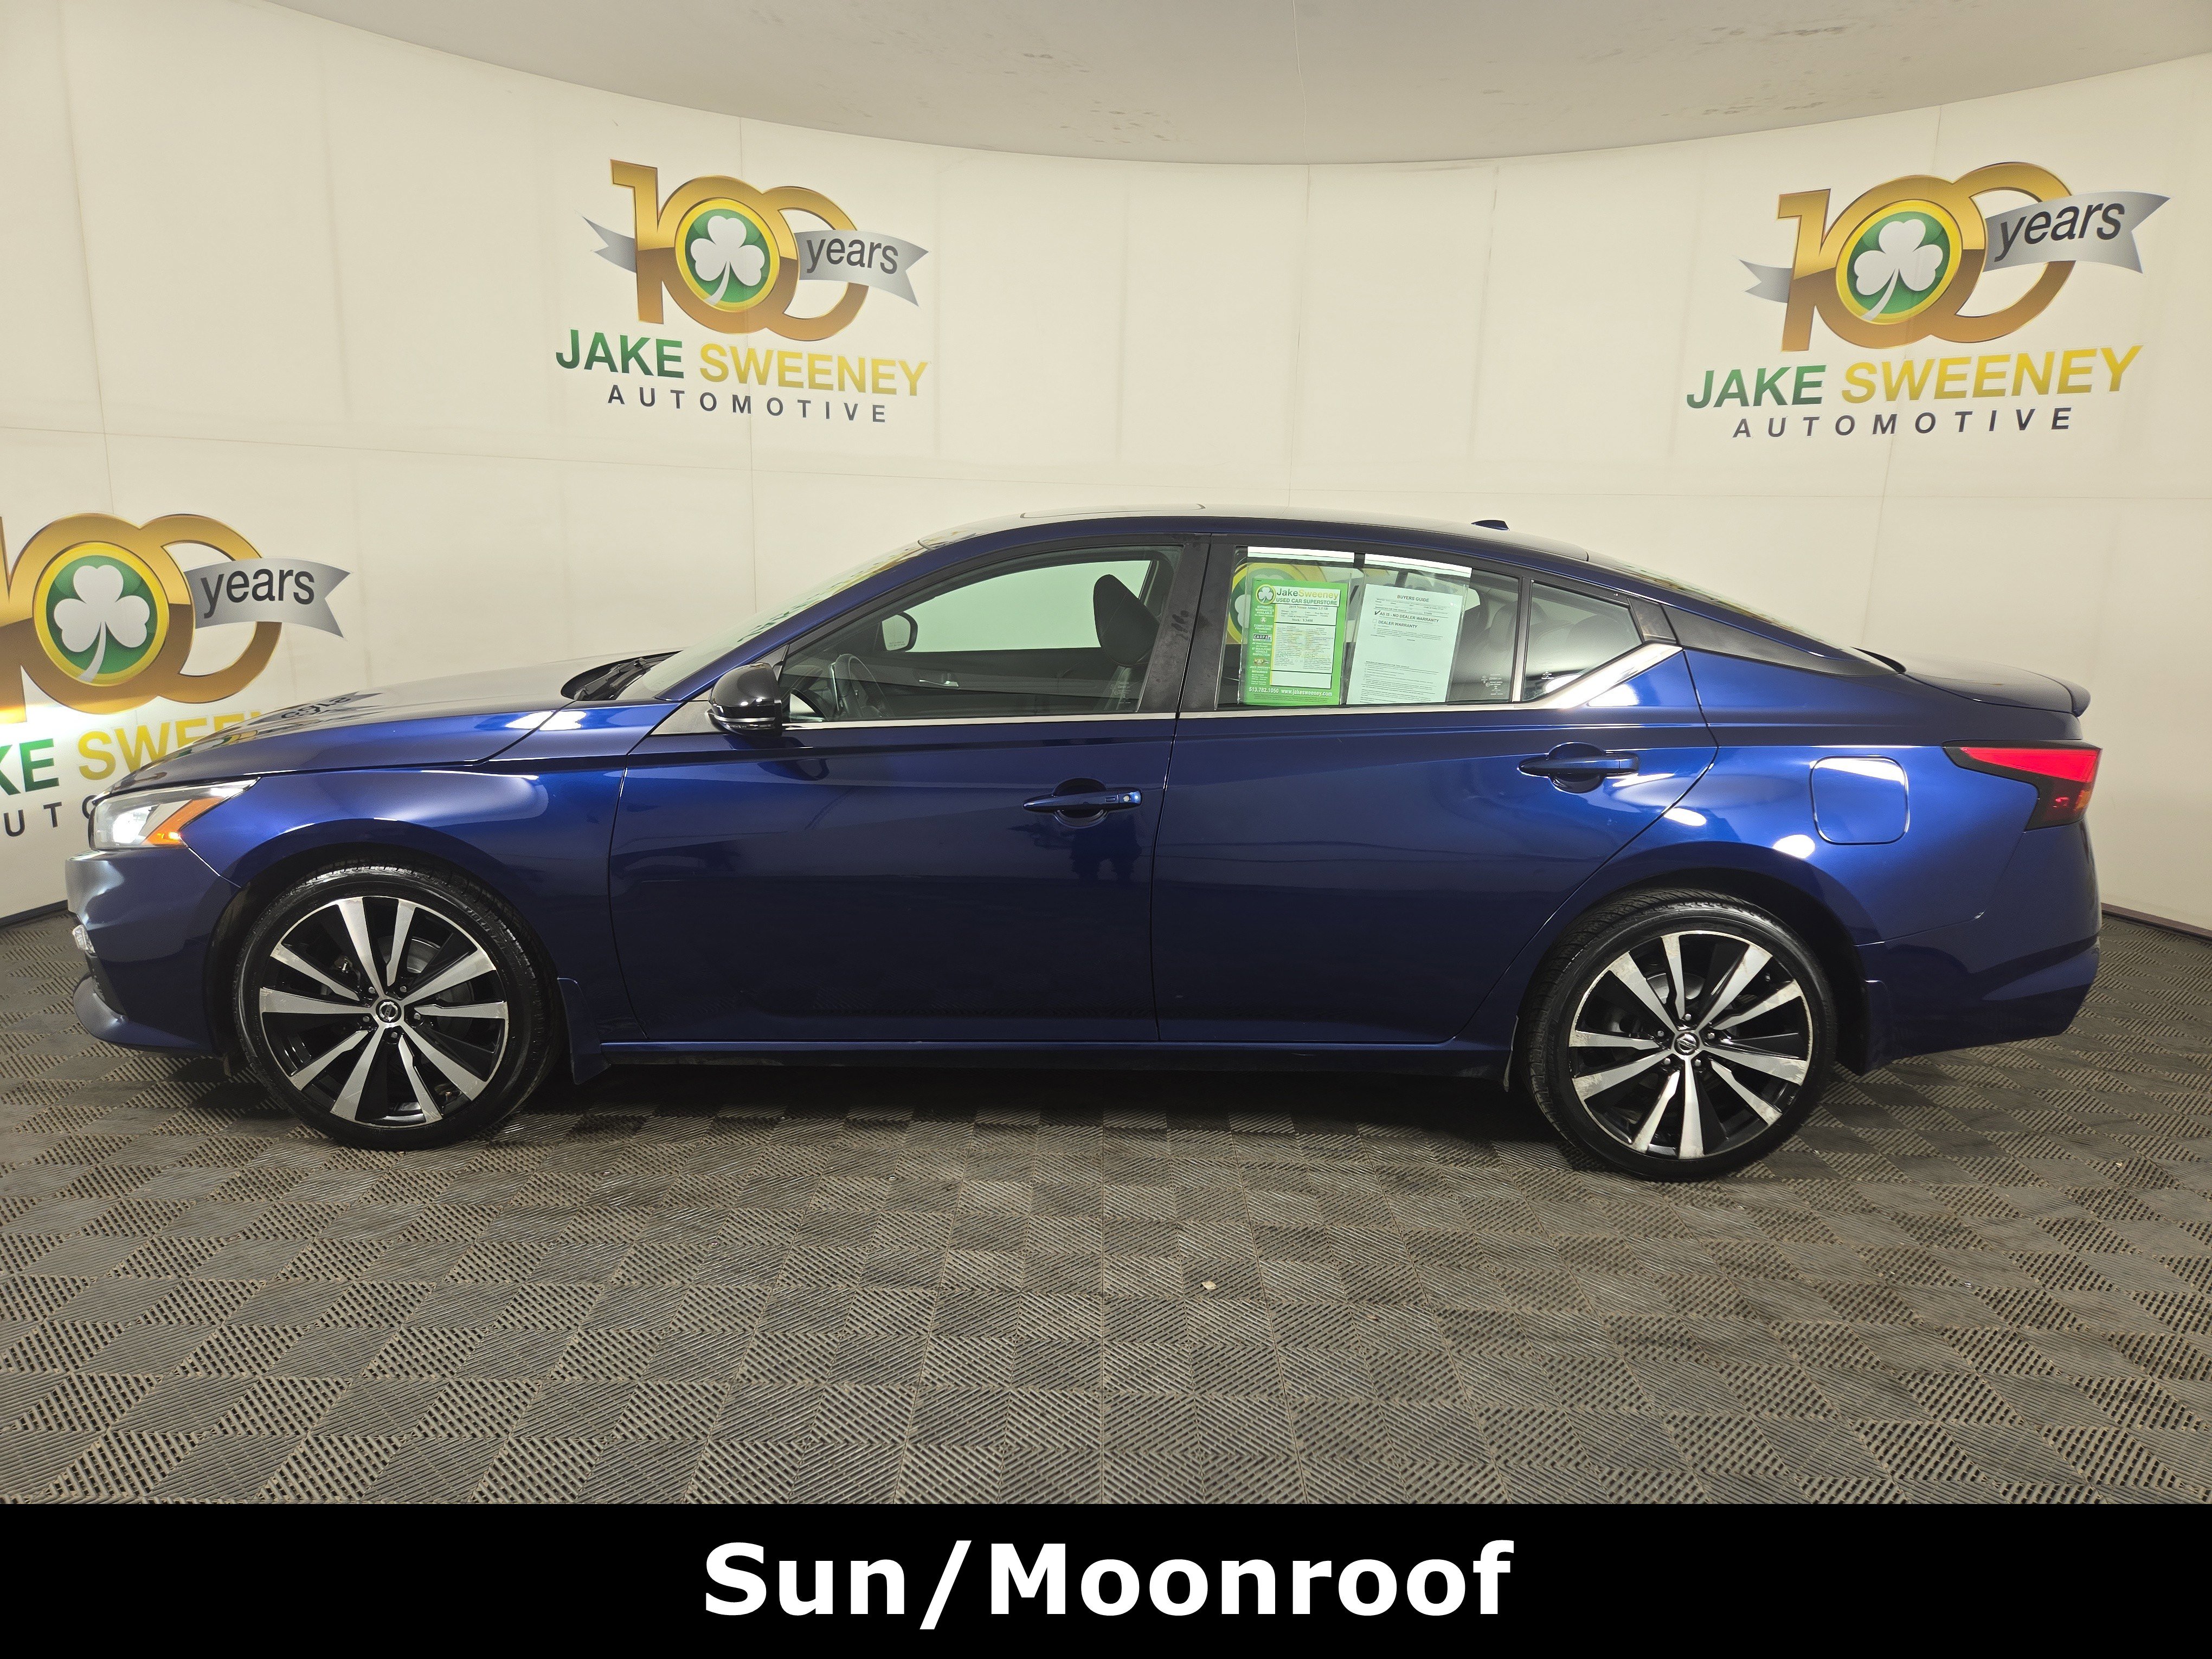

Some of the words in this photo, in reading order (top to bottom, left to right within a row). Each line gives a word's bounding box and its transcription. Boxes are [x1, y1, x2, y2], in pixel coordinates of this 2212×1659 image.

[806, 237, 899, 274] years
[1995, 202, 2125, 262] years
[556, 329, 685, 379] JAKE
[699, 343, 928, 396] SWEENEY
[1686, 364, 1826, 409] JAKE
[1841, 344, 2143, 403] SWEENEY
[607, 384, 886, 423] AUTOMOTIVE
[1732, 407, 2072, 438] AUTOMOTIVE
[200, 568, 316, 619] years
